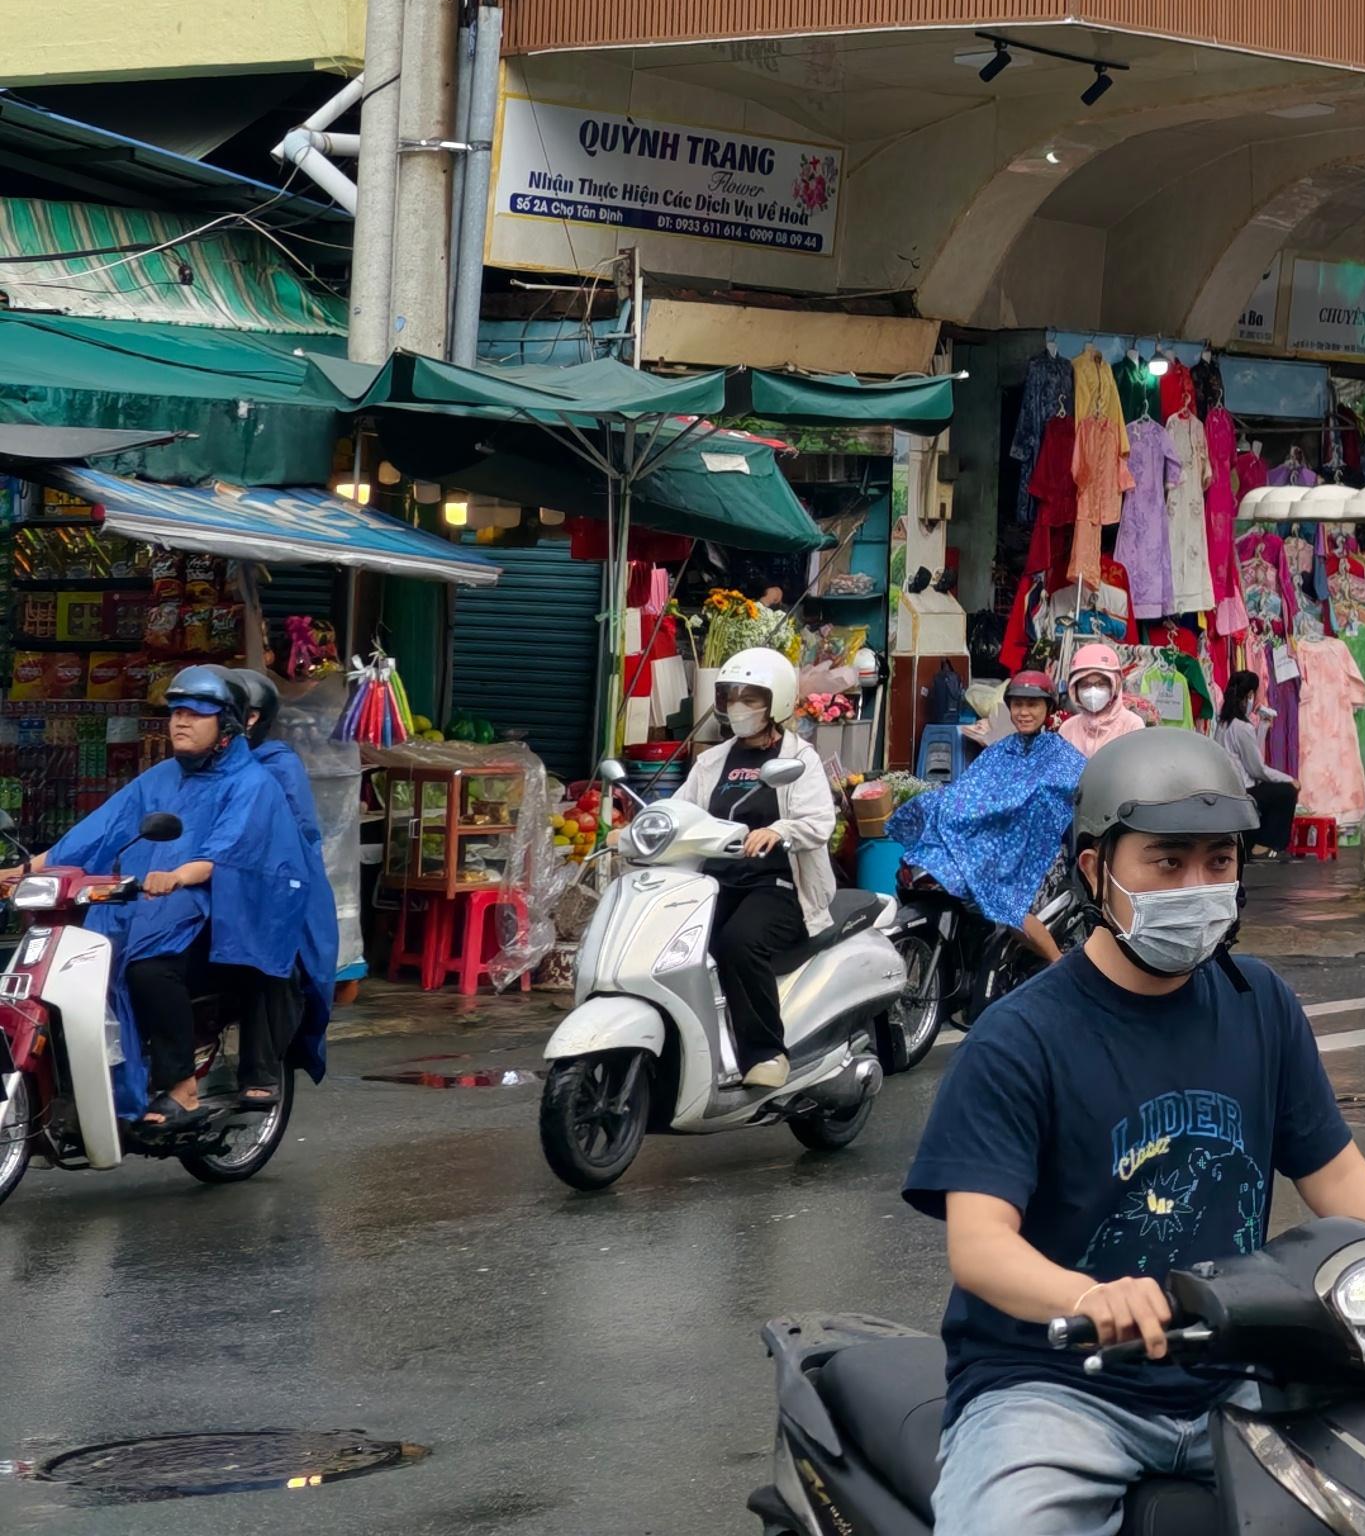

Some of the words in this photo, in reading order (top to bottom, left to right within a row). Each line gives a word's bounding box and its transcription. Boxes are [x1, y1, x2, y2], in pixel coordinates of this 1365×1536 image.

[579, 116, 681, 162] QUỲNH
[687, 135, 776, 176] TRANG
[528, 170, 574, 194] Nhận
[578, 177, 619, 202] Thực
[622, 181, 659, 207] Hiện
[662, 187, 693, 210] Các
[696, 194, 731, 217] Dịch
[733, 200, 754, 221] Vụ
[756, 201, 777, 222] Về
[708, 170, 767, 197] Flower
[533, 201, 548, 213] 2A
[576, 204, 597, 219] Tân
[599, 206, 624, 224] Định
